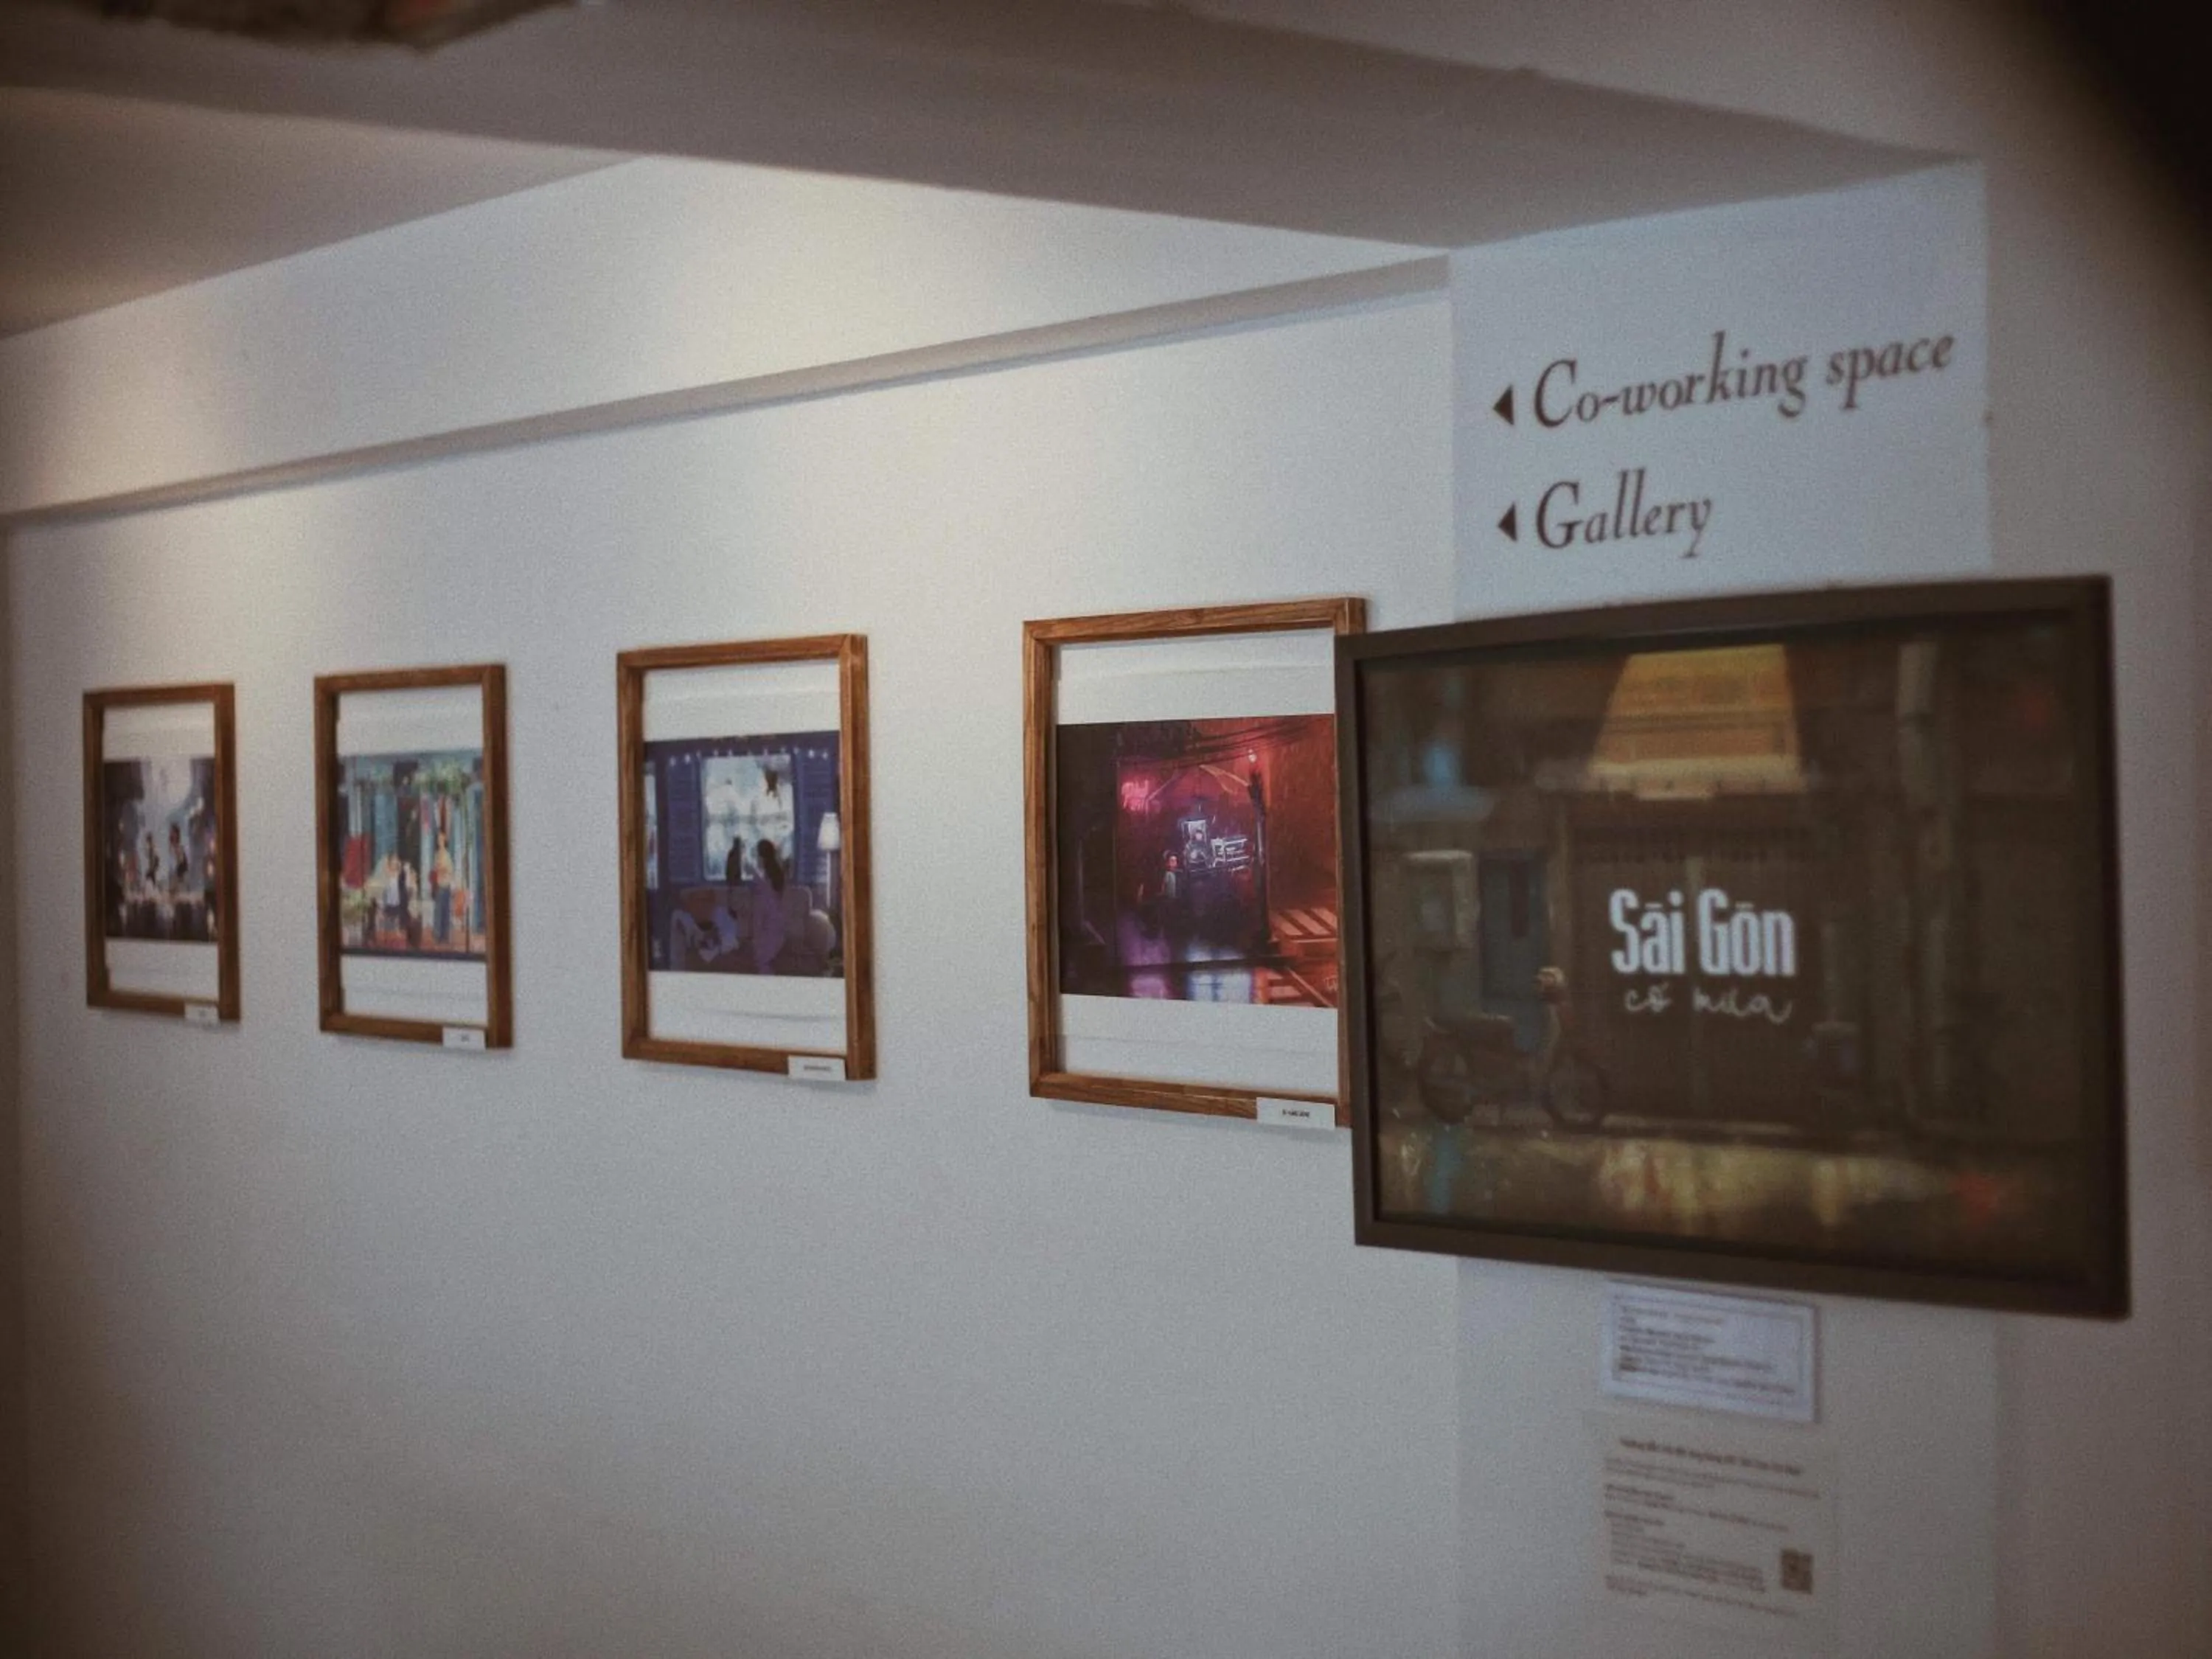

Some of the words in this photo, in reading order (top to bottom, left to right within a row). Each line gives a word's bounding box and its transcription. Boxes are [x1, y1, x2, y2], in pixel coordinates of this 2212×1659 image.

[1534, 330, 1808, 428] Co-working
[1826, 334, 1955, 411] space
[1535, 467, 1712, 559] Gallery
